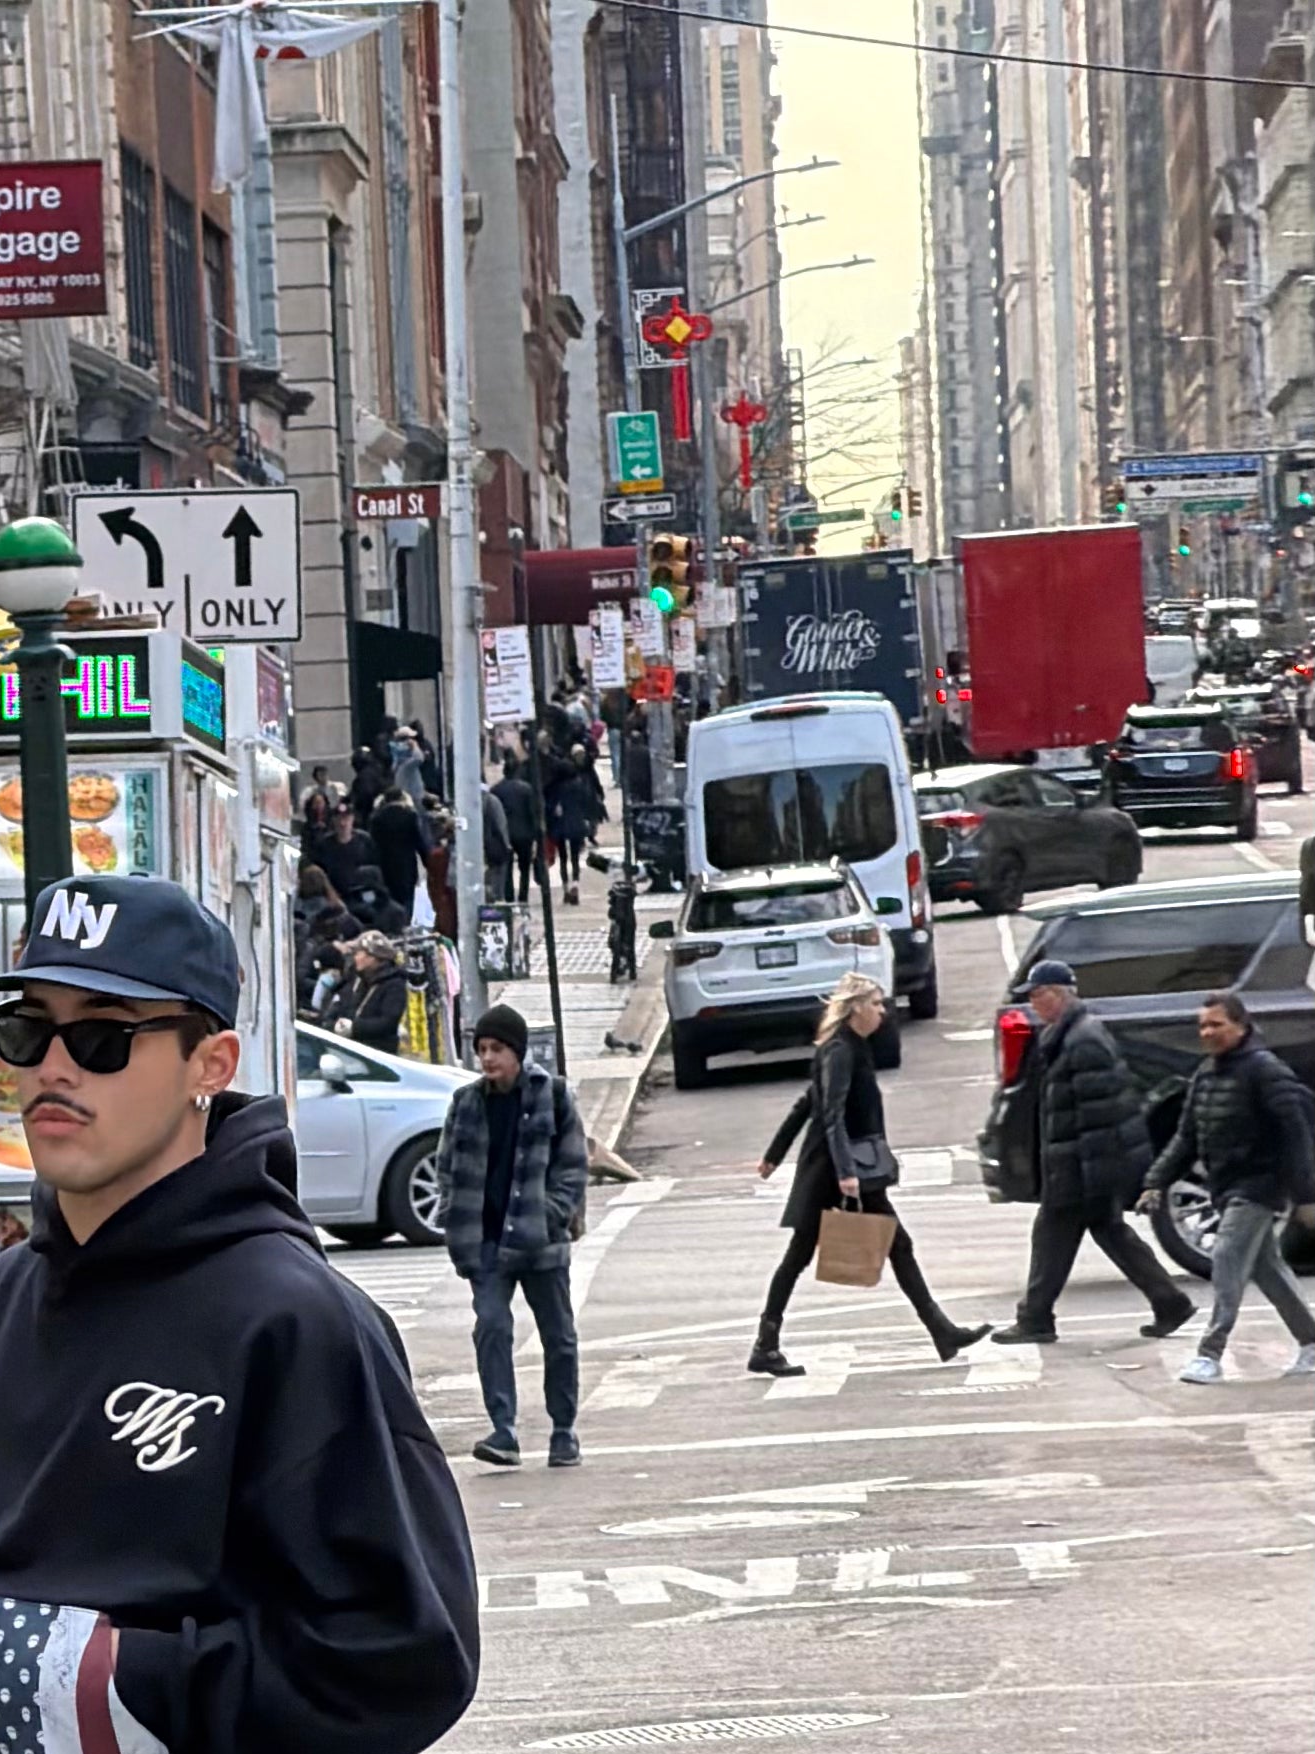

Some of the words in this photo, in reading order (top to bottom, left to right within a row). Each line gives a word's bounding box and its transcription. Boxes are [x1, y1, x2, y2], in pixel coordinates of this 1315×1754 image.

[39, 275, 59, 287] NY
[357, 493, 402, 516] Canal
[407, 493, 425, 514] St
[201, 597, 286, 627] ONLY
[131, 777, 148, 867] HALAL
